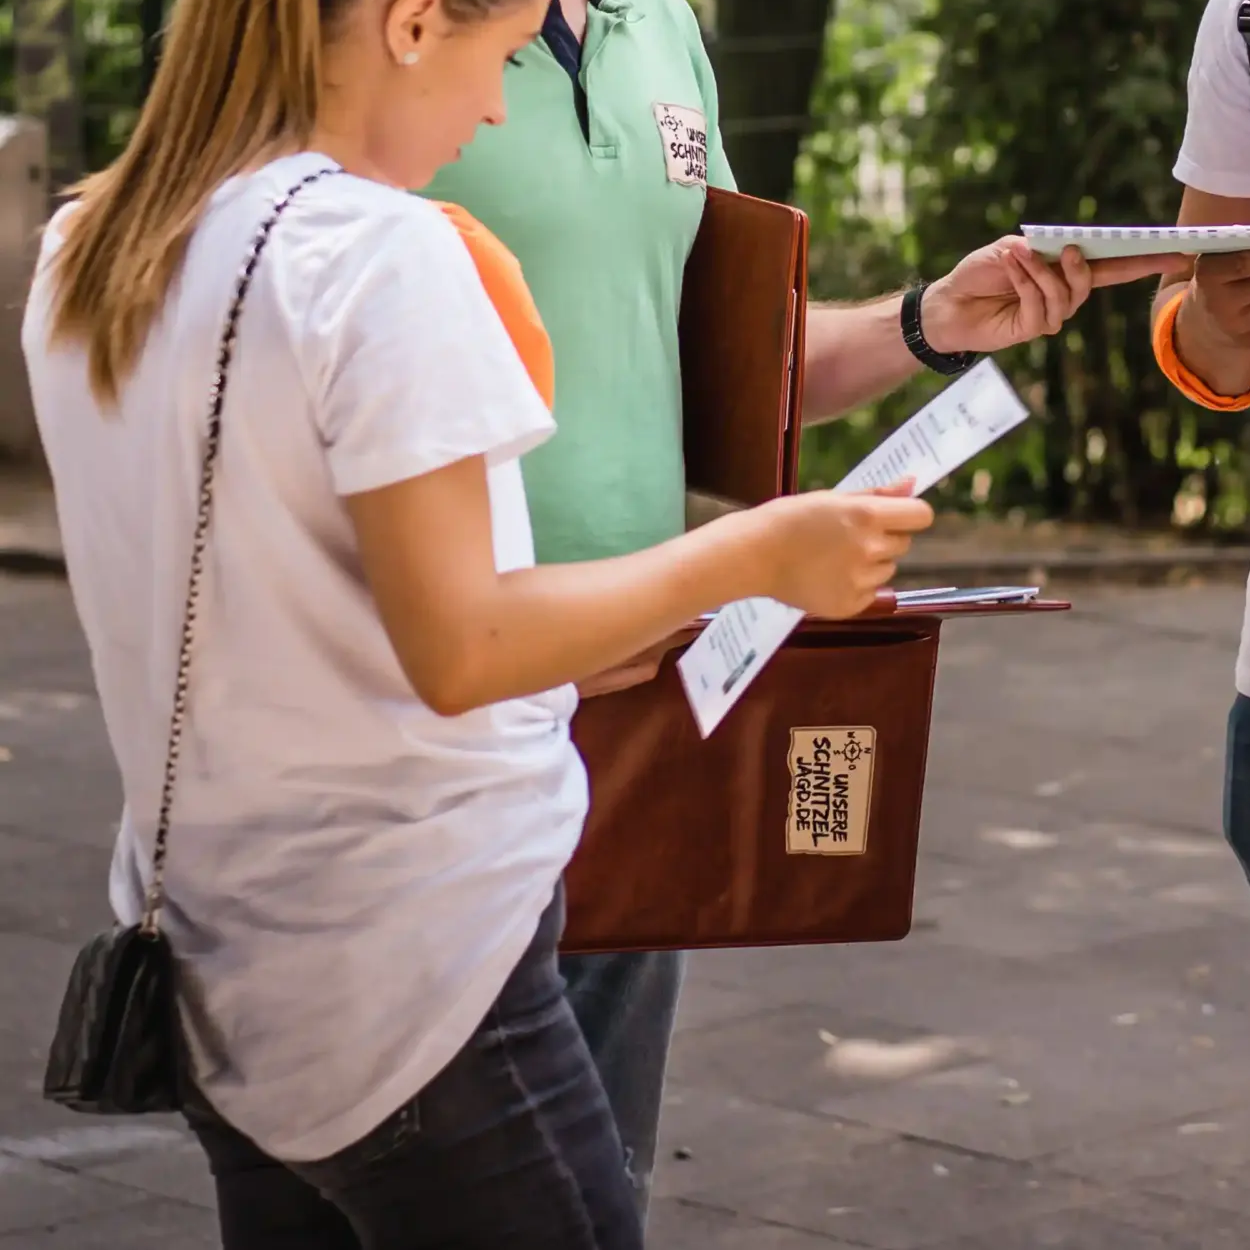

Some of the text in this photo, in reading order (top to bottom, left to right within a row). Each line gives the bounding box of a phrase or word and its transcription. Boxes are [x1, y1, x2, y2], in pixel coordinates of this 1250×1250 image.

[795, 756, 812, 832] JAGD.DE
[811, 736, 832, 847] SCHNITZEL
[830, 774, 848, 842] UNSERE
